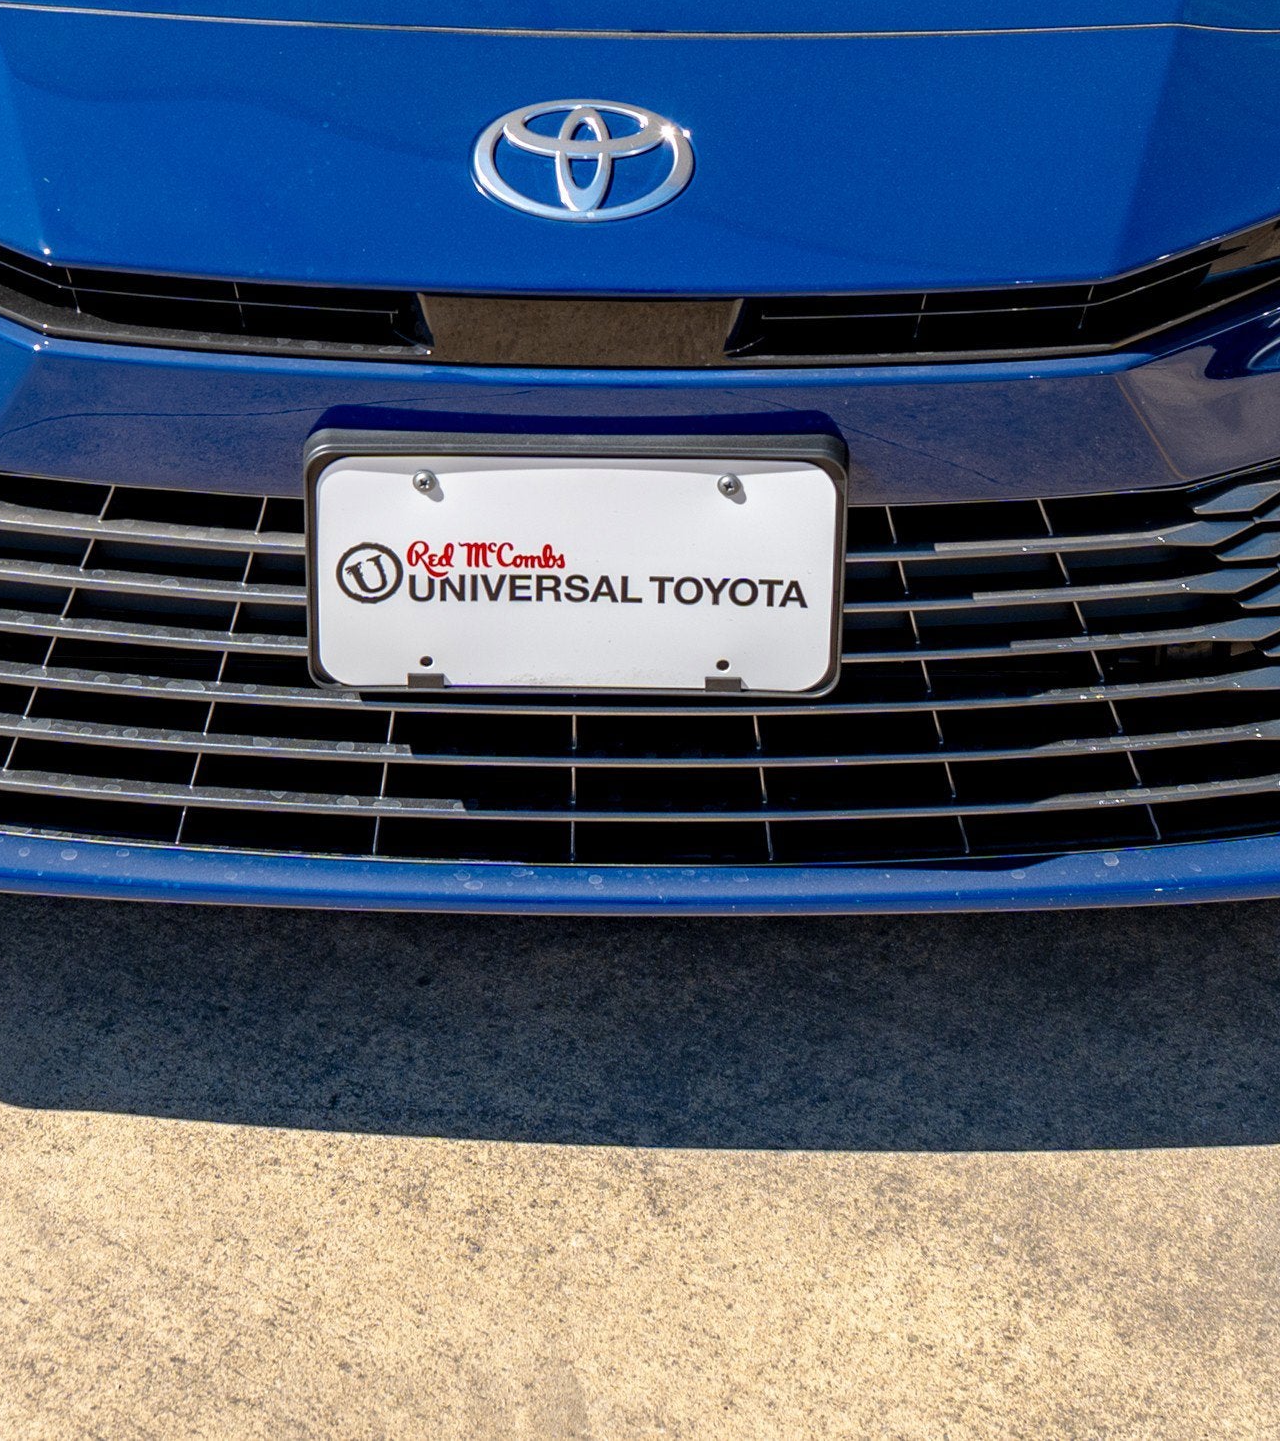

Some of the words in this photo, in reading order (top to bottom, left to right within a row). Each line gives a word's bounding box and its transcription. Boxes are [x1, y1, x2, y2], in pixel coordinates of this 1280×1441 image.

[407, 540, 455, 578] Red
[458, 542, 566, 569] McCombs
[408, 574, 643, 604] UNIVERSAL
[649, 576, 809, 609] TOYOTA
